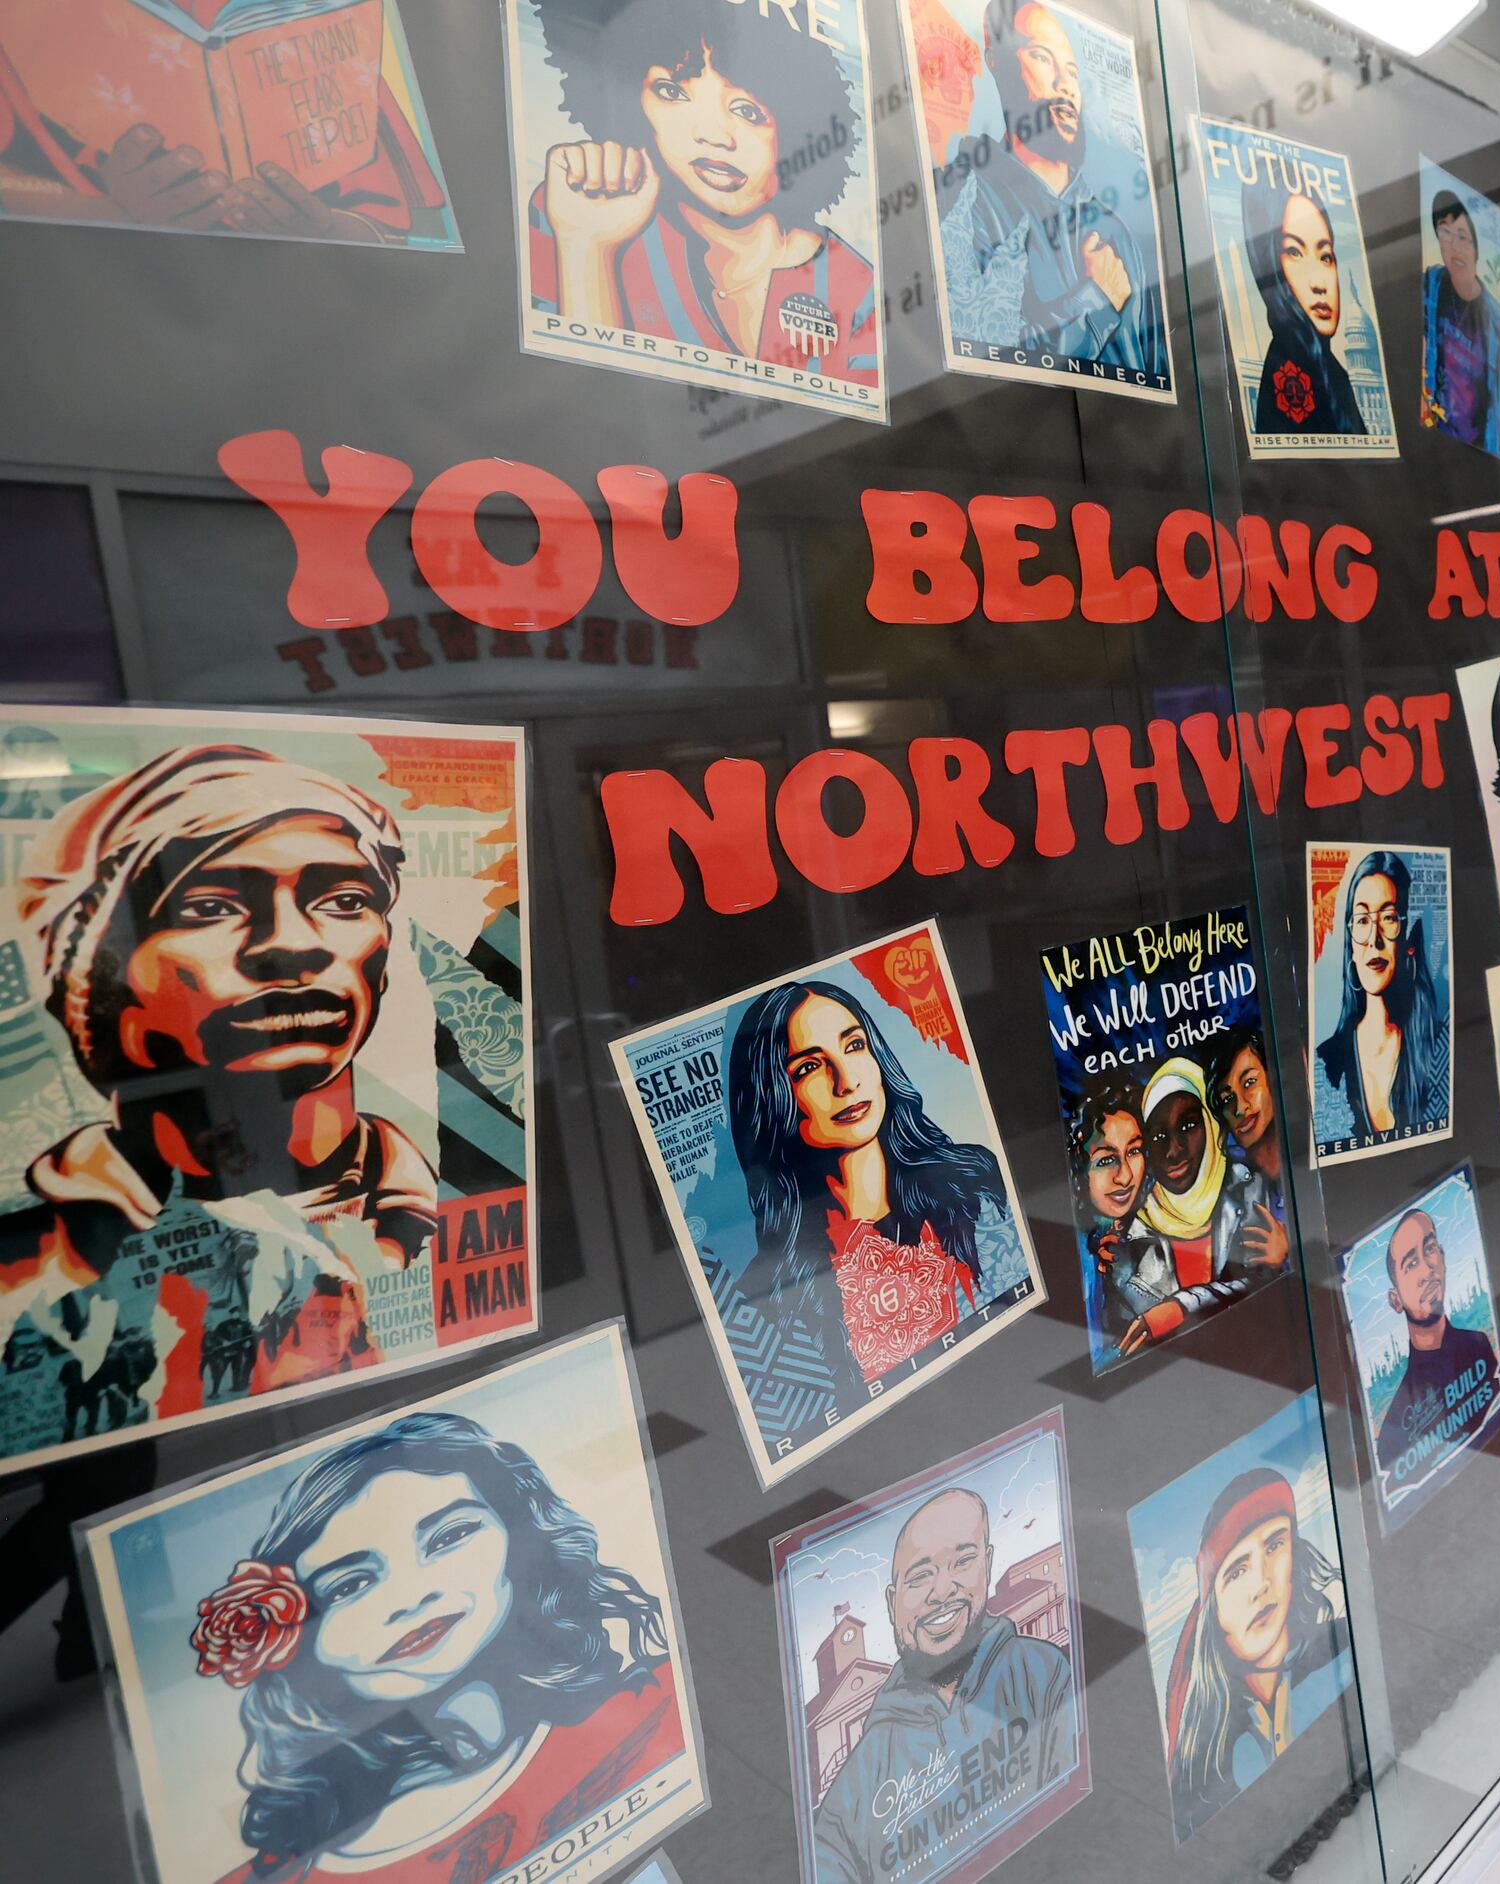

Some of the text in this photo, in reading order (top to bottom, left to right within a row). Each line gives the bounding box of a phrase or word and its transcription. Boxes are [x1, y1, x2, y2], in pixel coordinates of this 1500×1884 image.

[245, 43, 288, 92] THE
[281, 102, 370, 172] THE POET
[1251, 134, 1301, 158] WE THE
[1207, 138, 1347, 206] FUTURE
[783, 312, 837, 339] VOTER
[786, 299, 832, 320] FUTURE
[546, 317, 871, 401] POWER TO THE POLLS
[959, 340, 1168, 390] RECONNECT
[1255, 435, 1281, 446] RISE
[1285, 435, 1300, 446] TO
[1302, 435, 1350, 446] REWRITE
[1351, 435, 1370, 446] THE
[217, 430, 740, 632] YOU
[861, 488, 1379, 625] BELONG
[394, 759, 506, 773] GERRYMANDERING
[601, 692, 1452, 927] NORTHWEST
[1042, 946, 1085, 994] We
[1089, 935, 1136, 981] ALL
[1049, 1003, 1093, 1052] We
[1093, 981, 1156, 1035] Will
[635, 1044, 680, 1070] JOURNAL
[635, 1065, 682, 1105] SEE
[685, 1051, 720, 1086] NO
[645, 1078, 725, 1129] STRANGER
[657, 1132, 679, 1151] TIME
[680, 1127, 692, 1140] TO
[665, 1146, 710, 1174] OF HUMAN
[1316, 1117, 1450, 1157] REENVISION
[669, 1164, 699, 1184] VALUE
[167, 1243, 200, 1262] YET
[437, 1199, 525, 1265] I AM
[132, 1271, 157, 1289] TO
[366, 1264, 431, 1297] VOTING
[367, 1287, 432, 1313] RIGHTS ARE
[440, 1260, 527, 1328] A MAN
[368, 1302, 433, 1332] HUMAN
[774, 1283, 1031, 1459] REBIRTH
[1443, 1358, 1488, 1410] BUILD
[1394, 1380, 1495, 1482] COMMUNITIES
[959, 1716, 1030, 1788] END
[879, 1744, 1033, 1873] GUN VIOLENCE
